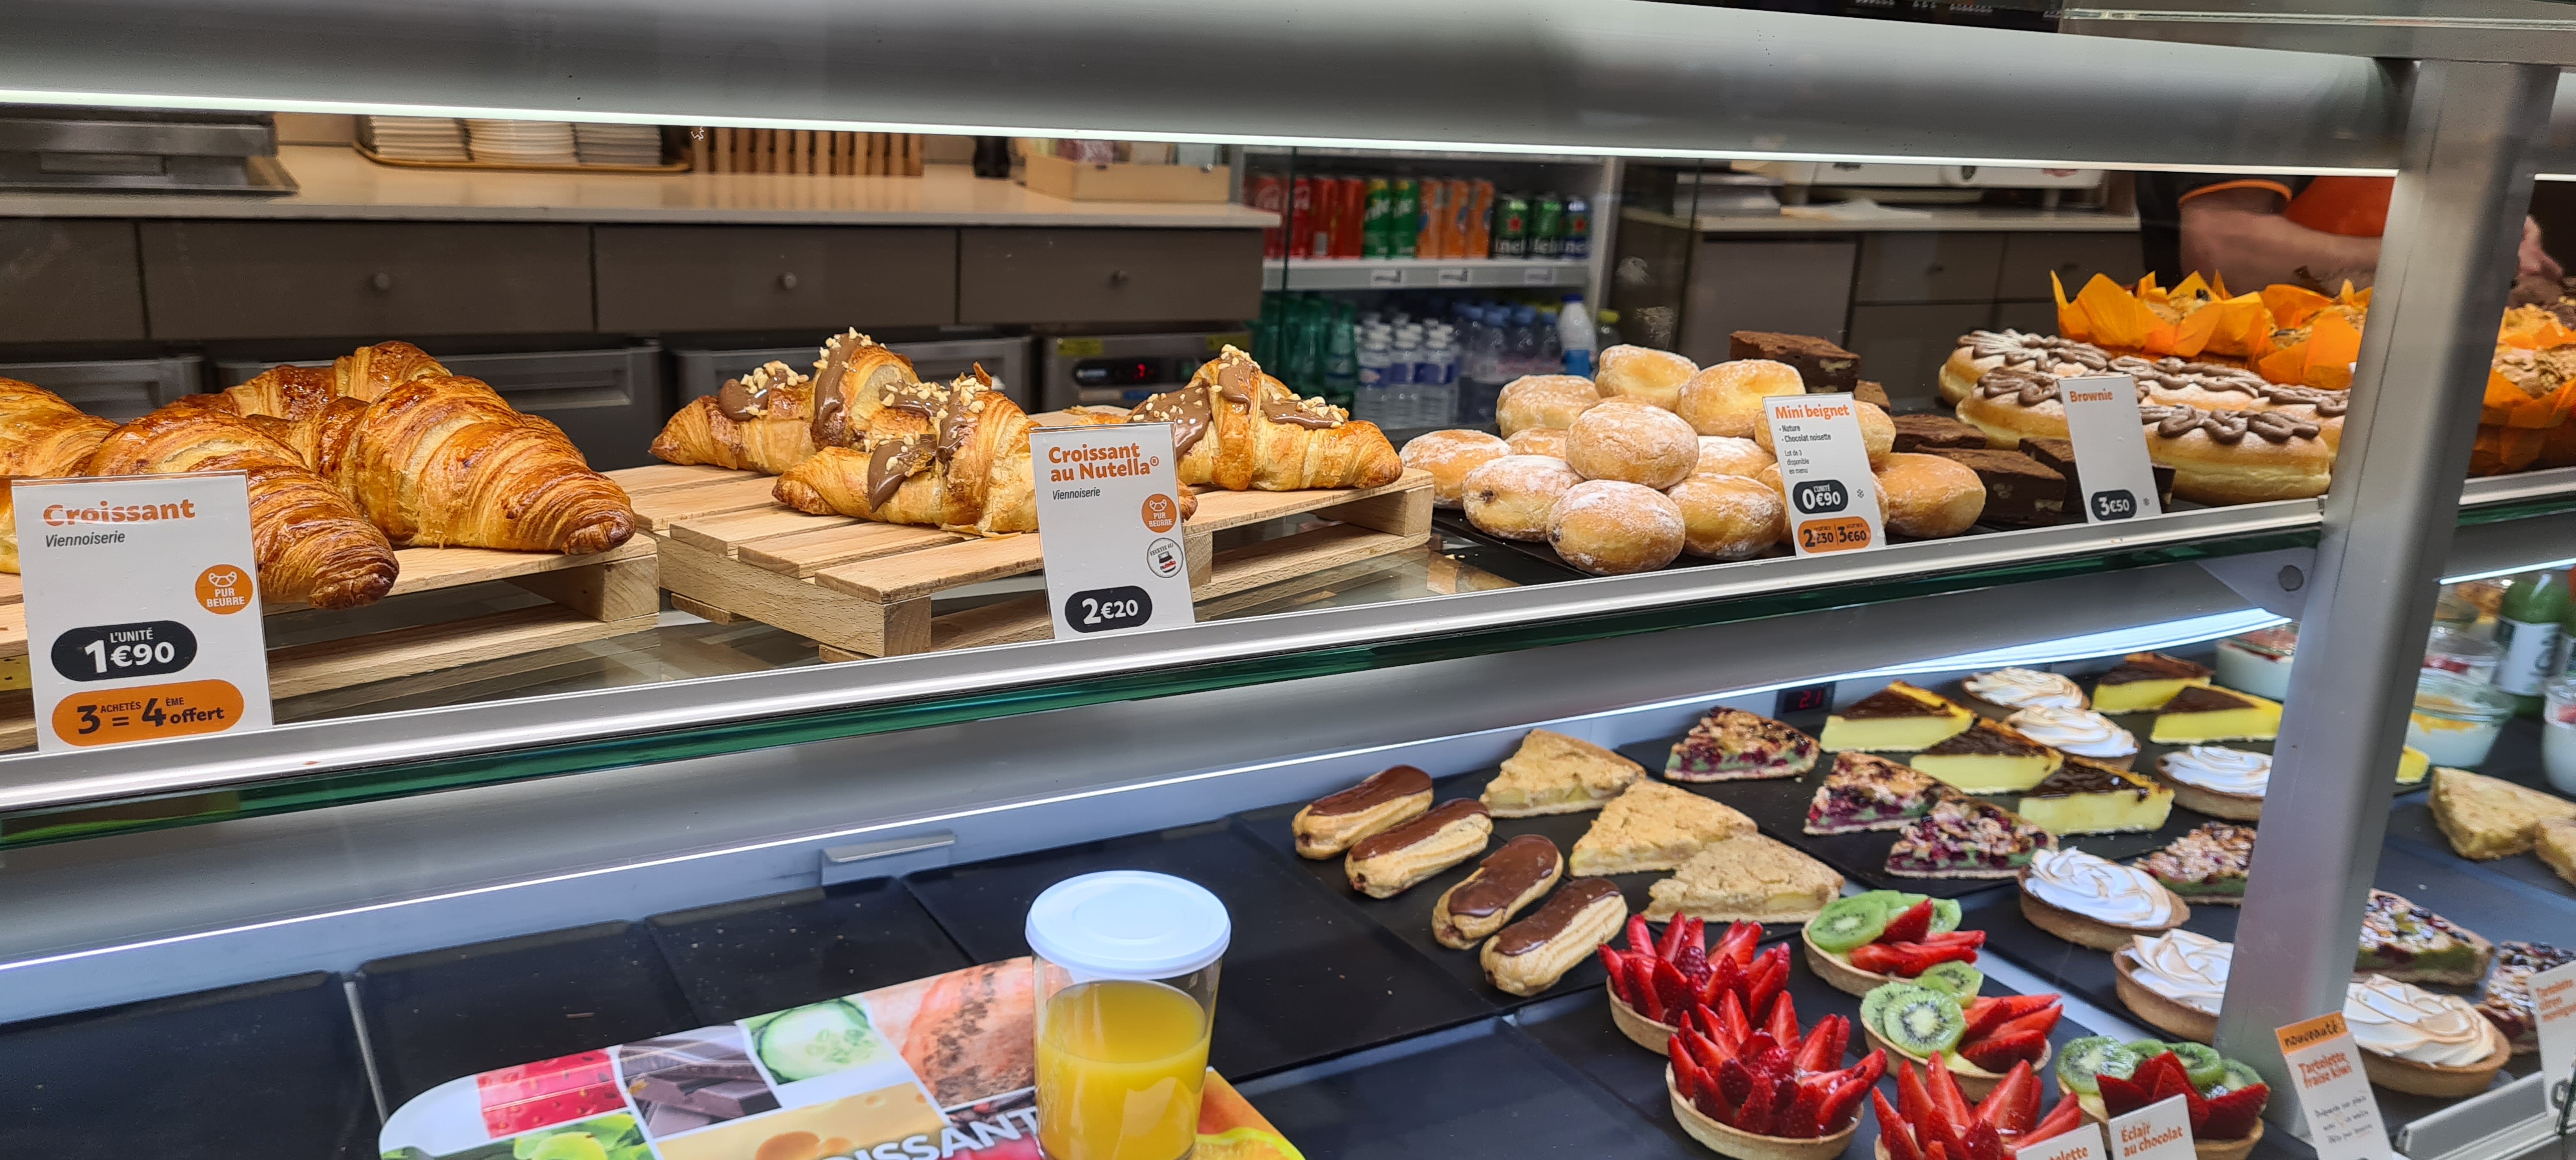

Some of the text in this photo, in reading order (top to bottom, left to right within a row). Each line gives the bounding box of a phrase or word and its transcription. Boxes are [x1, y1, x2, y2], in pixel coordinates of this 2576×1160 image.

[2069, 388, 2113, 403] Brownie
[1775, 404, 1850, 420] Mini beignet
[1784, 434, 1809, 442] Chocolat
[1048, 442, 1140, 464] Croissant
[1050, 469, 1075, 482] au
[1052, 487, 1101, 500] Viennoiserie
[1802, 487, 1841, 510] 0€90
[43, 499, 195, 526] Croissant
[2099, 496, 2130, 515] 3€50
[1149, 519, 1172, 528] BEURRE
[1153, 512, 1166, 520] PUR
[45, 531, 126, 547] Viennoiserie
[1837, 526, 1867, 543] 3€60
[214, 588, 235, 598] PUR
[206, 597, 245, 607] BEURRE
[1082, 598, 1138, 625] 2€20
[110, 627, 154, 643] L'UNITÉ
[84, 639, 175, 673] 1€90
[100, 700, 142, 713] ACHETÉS
[165, 696, 185, 706] ÈME
[76, 705, 101, 735] 3
[141, 698, 166, 727] 4
[170, 706, 225, 725] offert
[2121, 1122, 2151, 1143] Éclair
[2124, 1126, 2184, 1157] au chocolat
